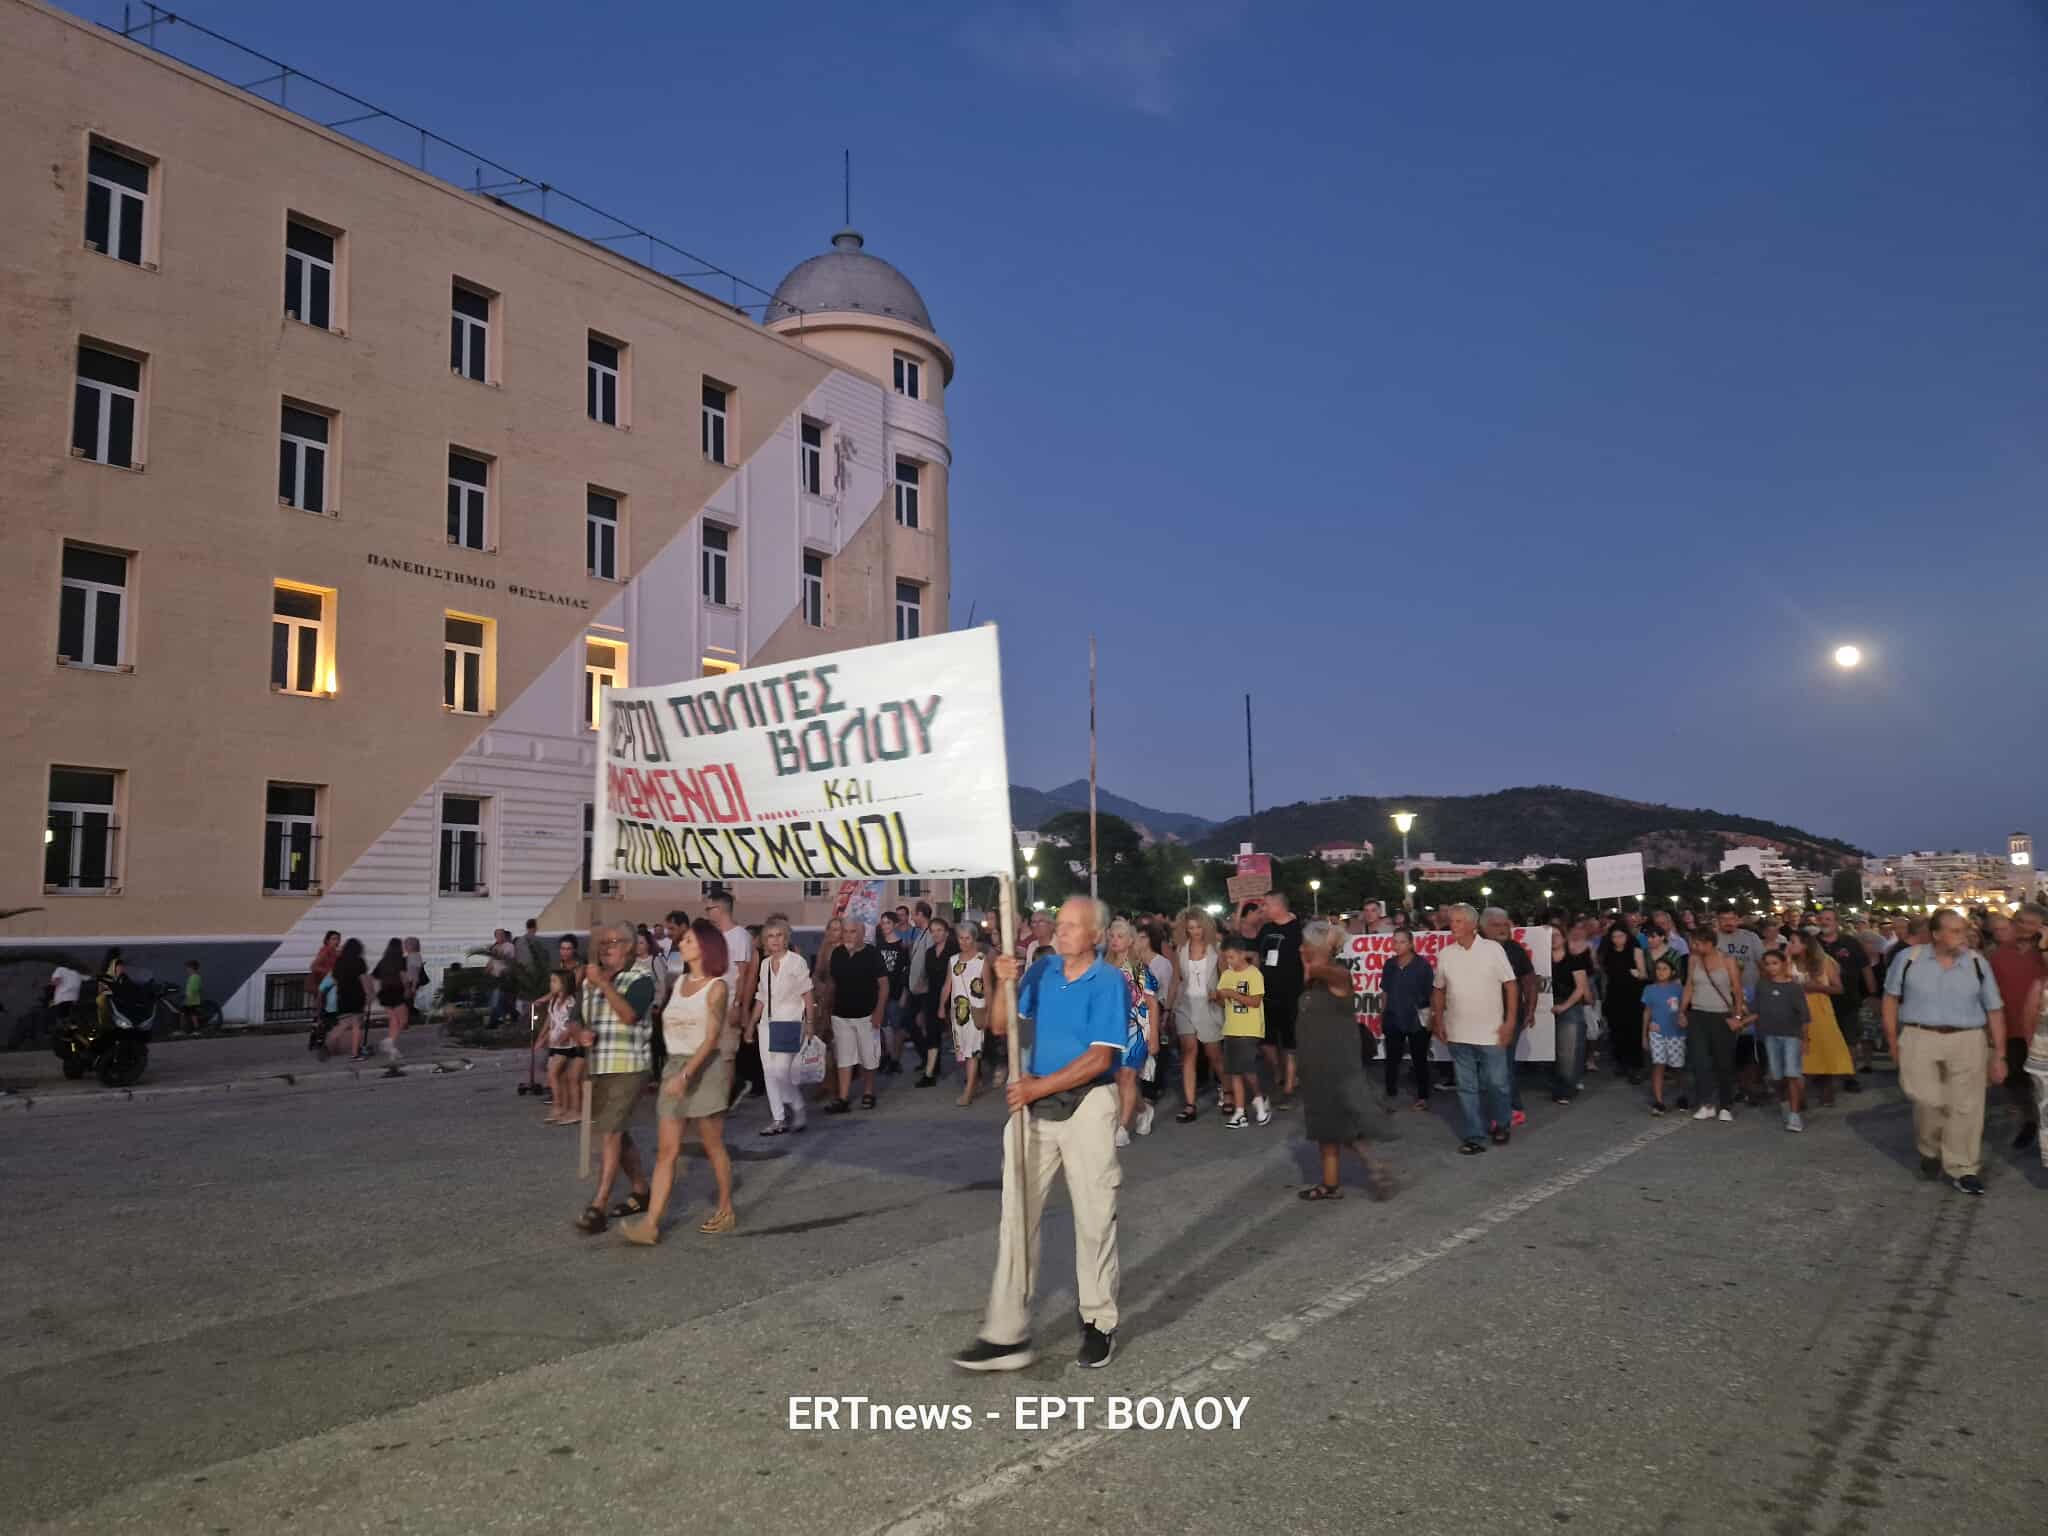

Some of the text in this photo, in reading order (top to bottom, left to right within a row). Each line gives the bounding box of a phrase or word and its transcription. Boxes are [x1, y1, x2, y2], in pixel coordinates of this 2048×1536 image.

[367, 553, 590, 609] ΠΑΝΕΠΙΣΤΗΜΙΟ ΘΕΣΣΑΛΙΑΣ
[667, 664, 846, 737] ΠΟΛΙΤΕΣ
[767, 694, 943, 776] ΒΟΛΟΥ
